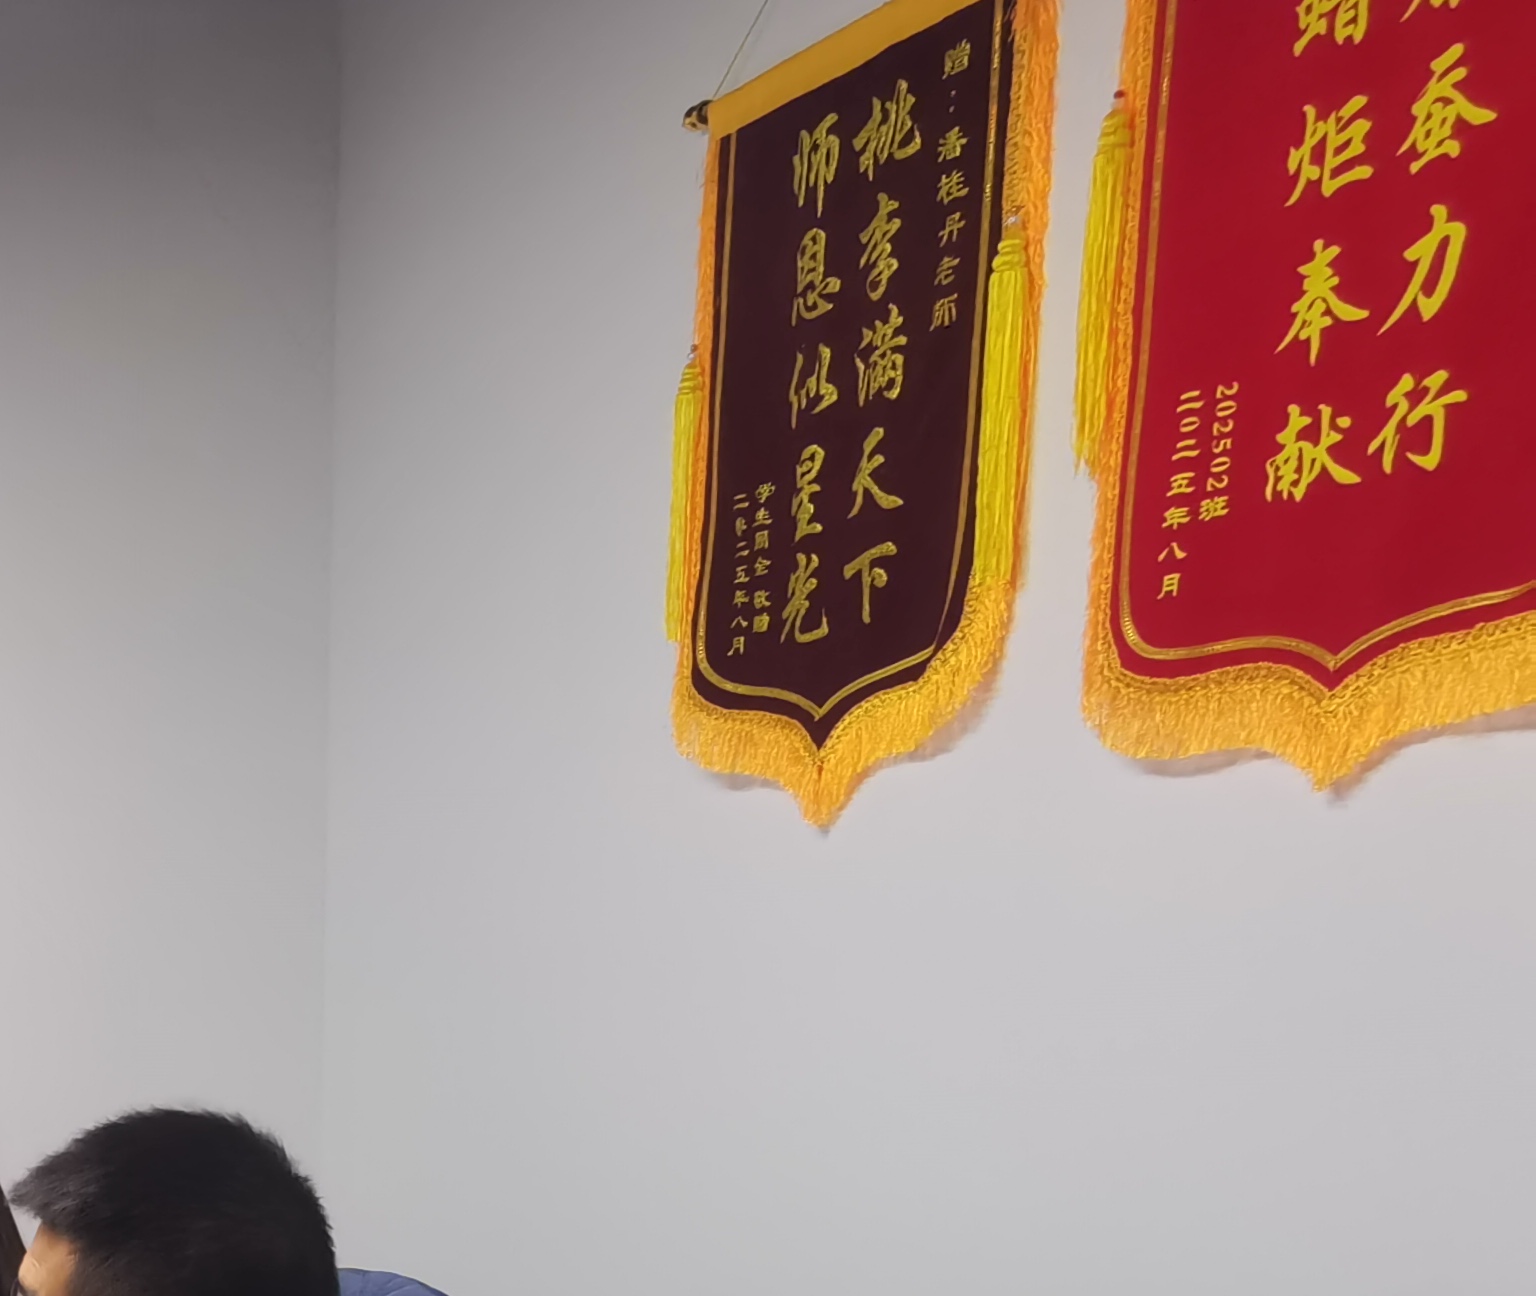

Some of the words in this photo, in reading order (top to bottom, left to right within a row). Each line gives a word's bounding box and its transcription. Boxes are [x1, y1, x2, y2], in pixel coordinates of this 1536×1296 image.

[781, 113, 840, 645] 师恩似星光
[844, 80, 920, 624] 桃李满天下
[1198, 381, 1239, 521] 202502班
[1367, 0, 1497, 474] 蚕力行
